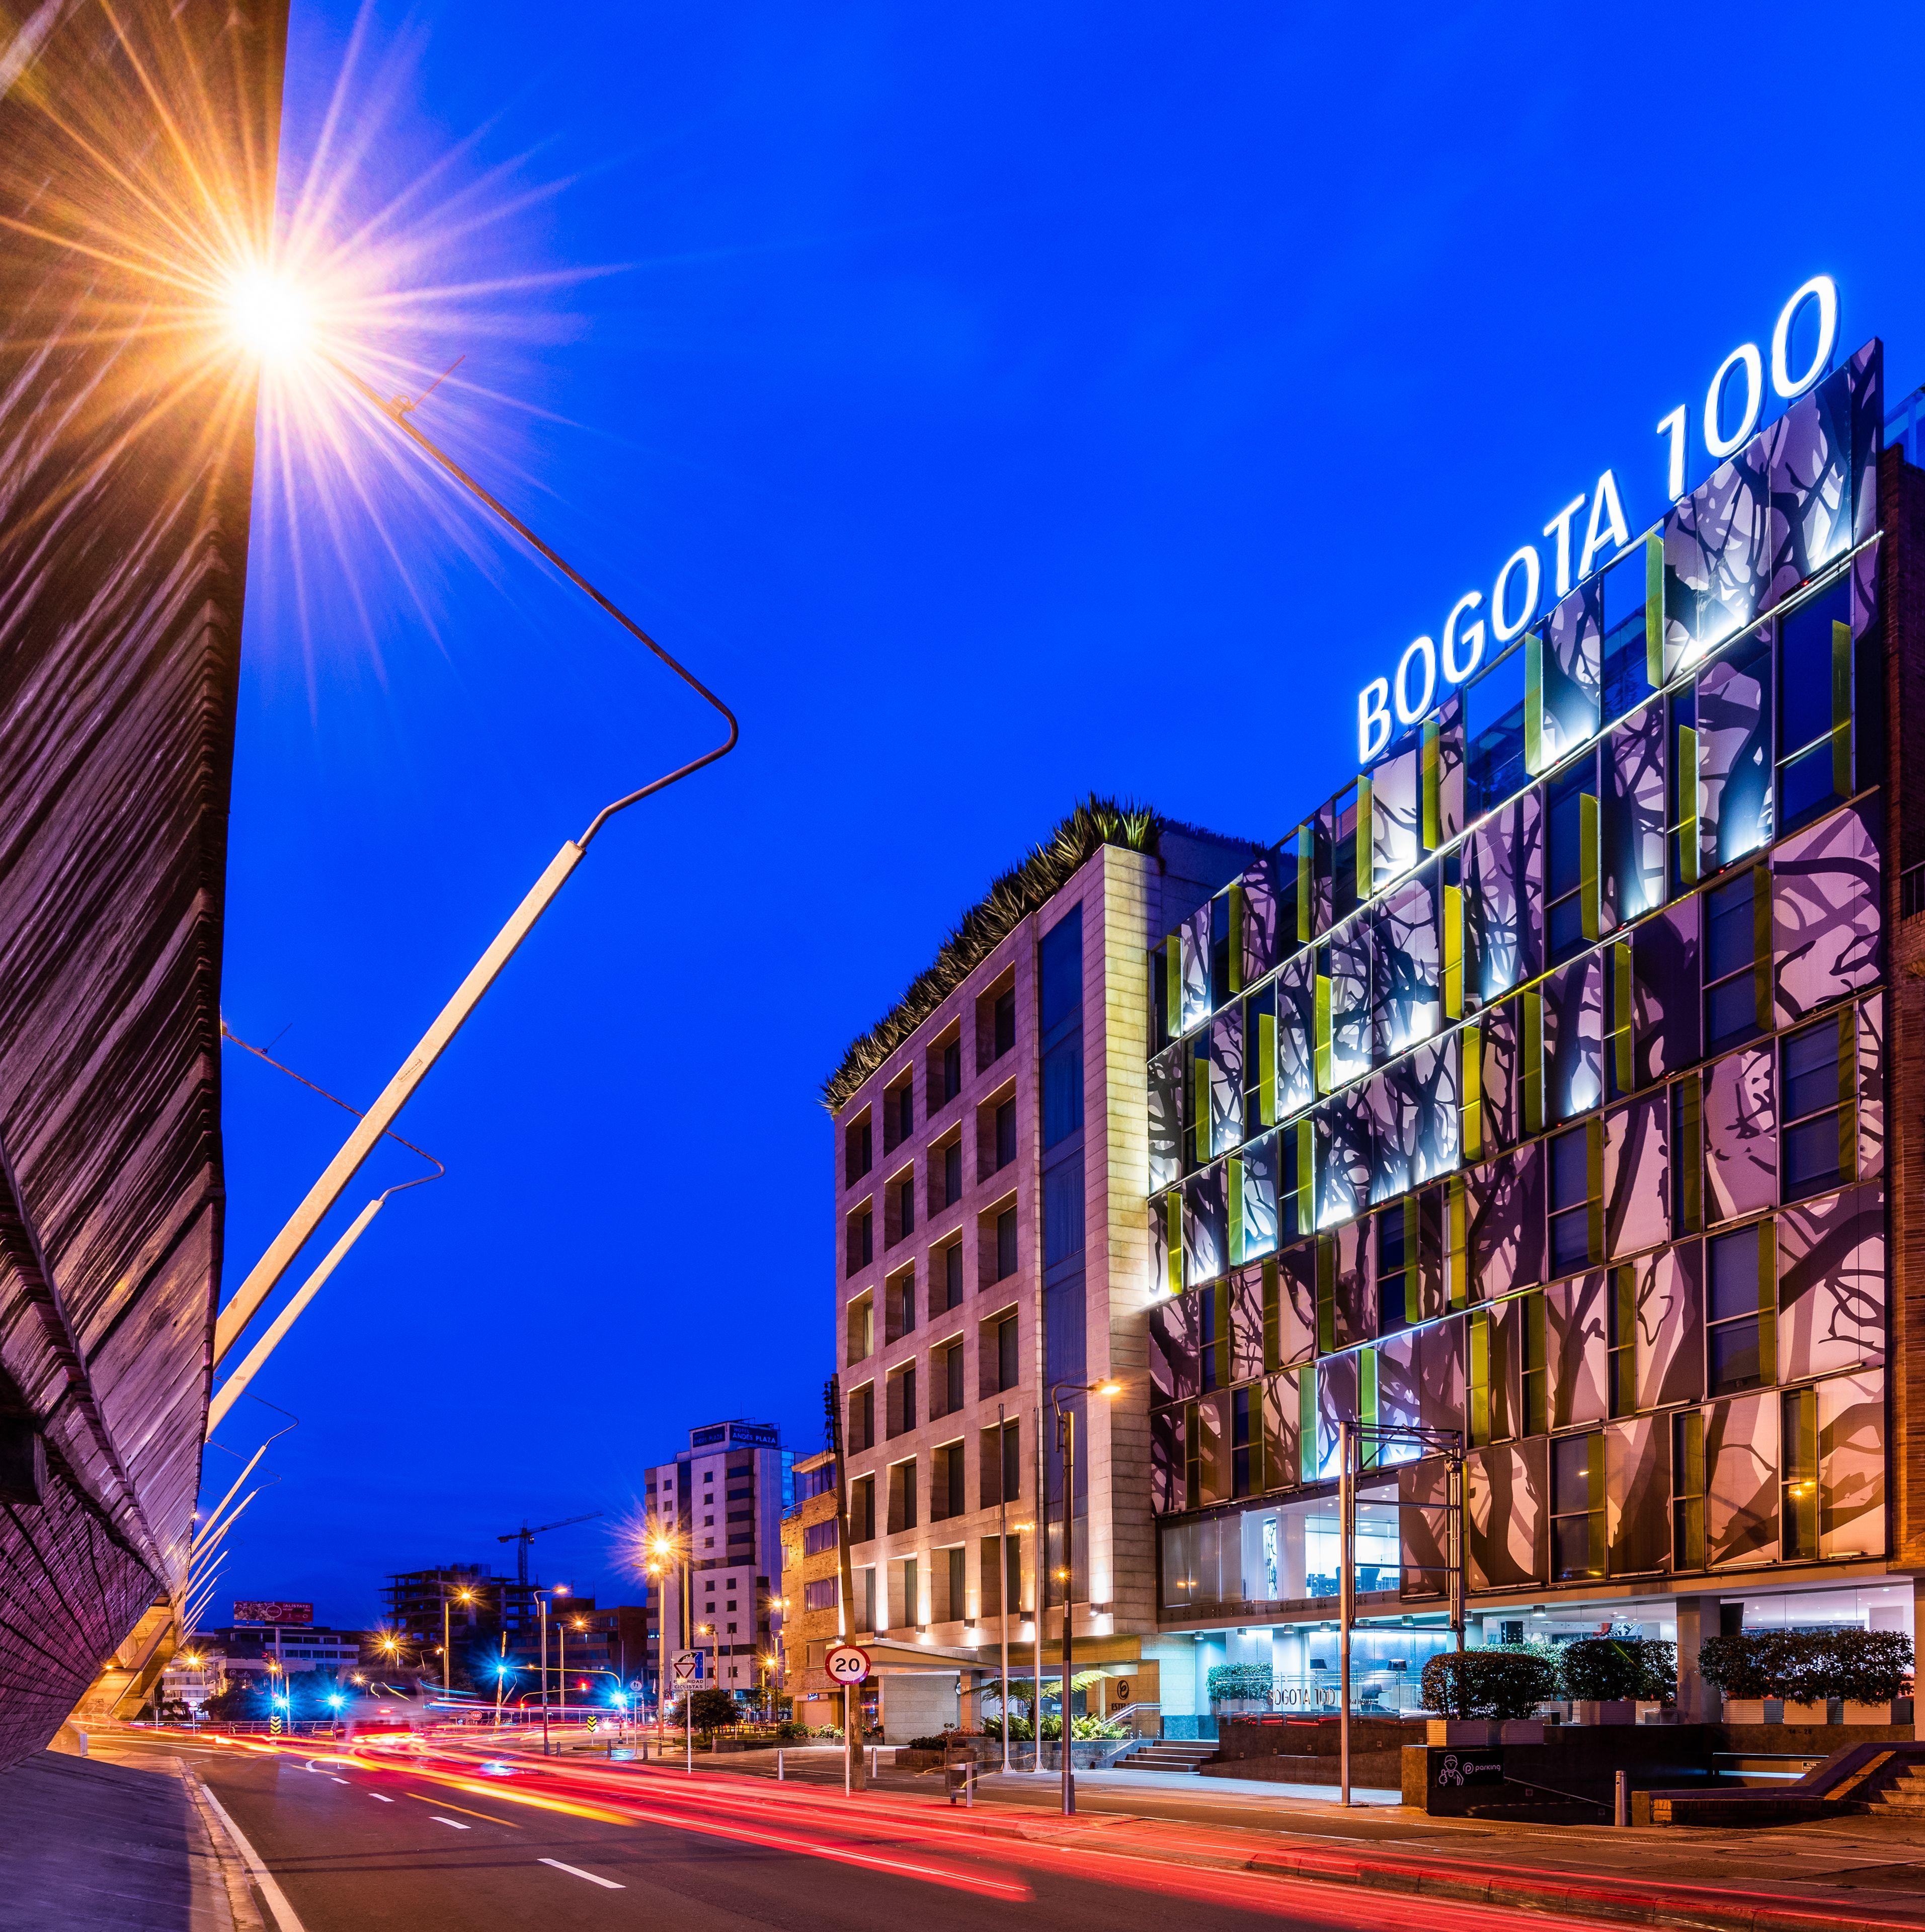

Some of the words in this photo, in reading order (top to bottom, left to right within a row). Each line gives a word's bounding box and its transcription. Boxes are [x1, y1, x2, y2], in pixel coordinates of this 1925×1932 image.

[1359, 468, 1629, 765] BOGOTA
[1657, 275, 1840, 504] 100
[756, 1435, 776, 1444] PLAZA
[835, 1658, 860, 1672] 20
[1267, 1688, 1311, 1705] BOGOTA
[1314, 1688, 1336, 1705] 100
